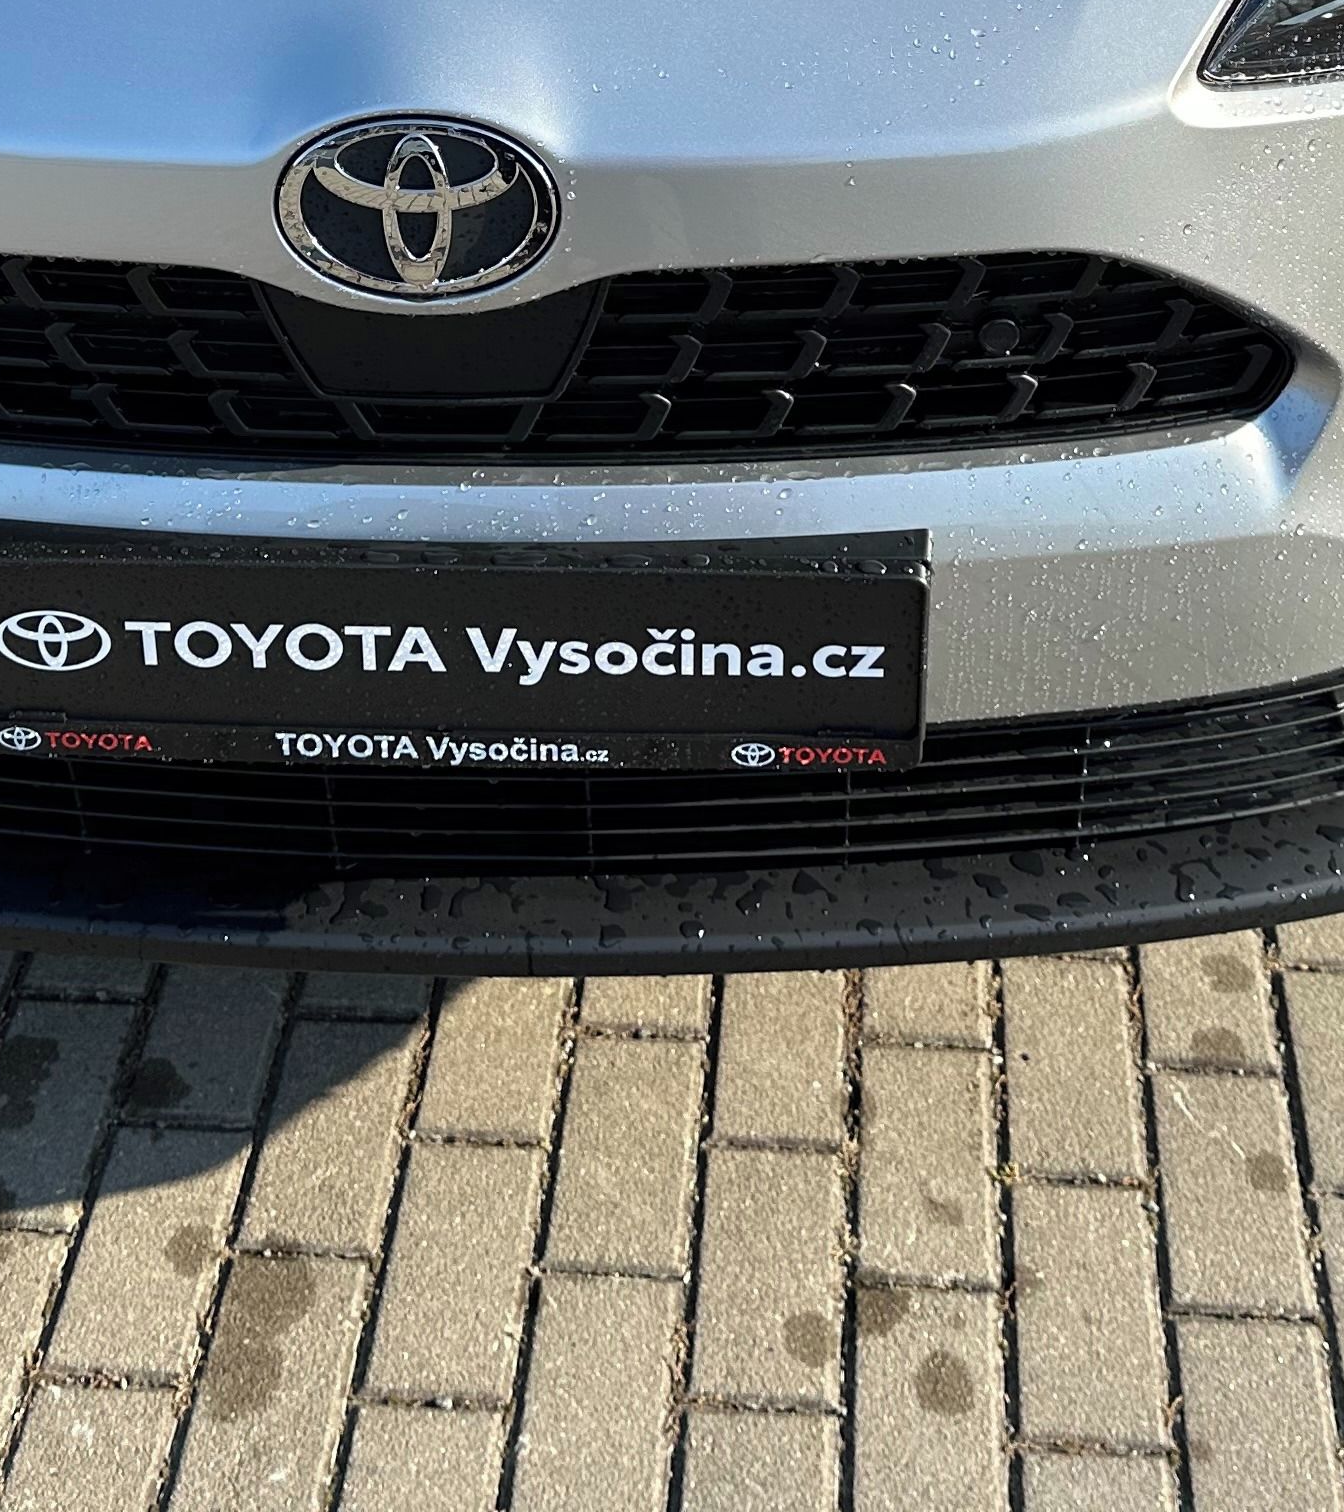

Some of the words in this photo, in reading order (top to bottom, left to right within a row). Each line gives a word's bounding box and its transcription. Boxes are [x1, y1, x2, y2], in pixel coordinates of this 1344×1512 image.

[124, 620, 447, 672] TOYOTA
[465, 626, 886, 685] Vysočina.cz
[45, 731, 154, 751] TOYOTA
[275, 731, 419, 760] TOYOTA
[425, 735, 609, 766] Vysočina.cz
[778, 745, 887, 765] TOYOTA
